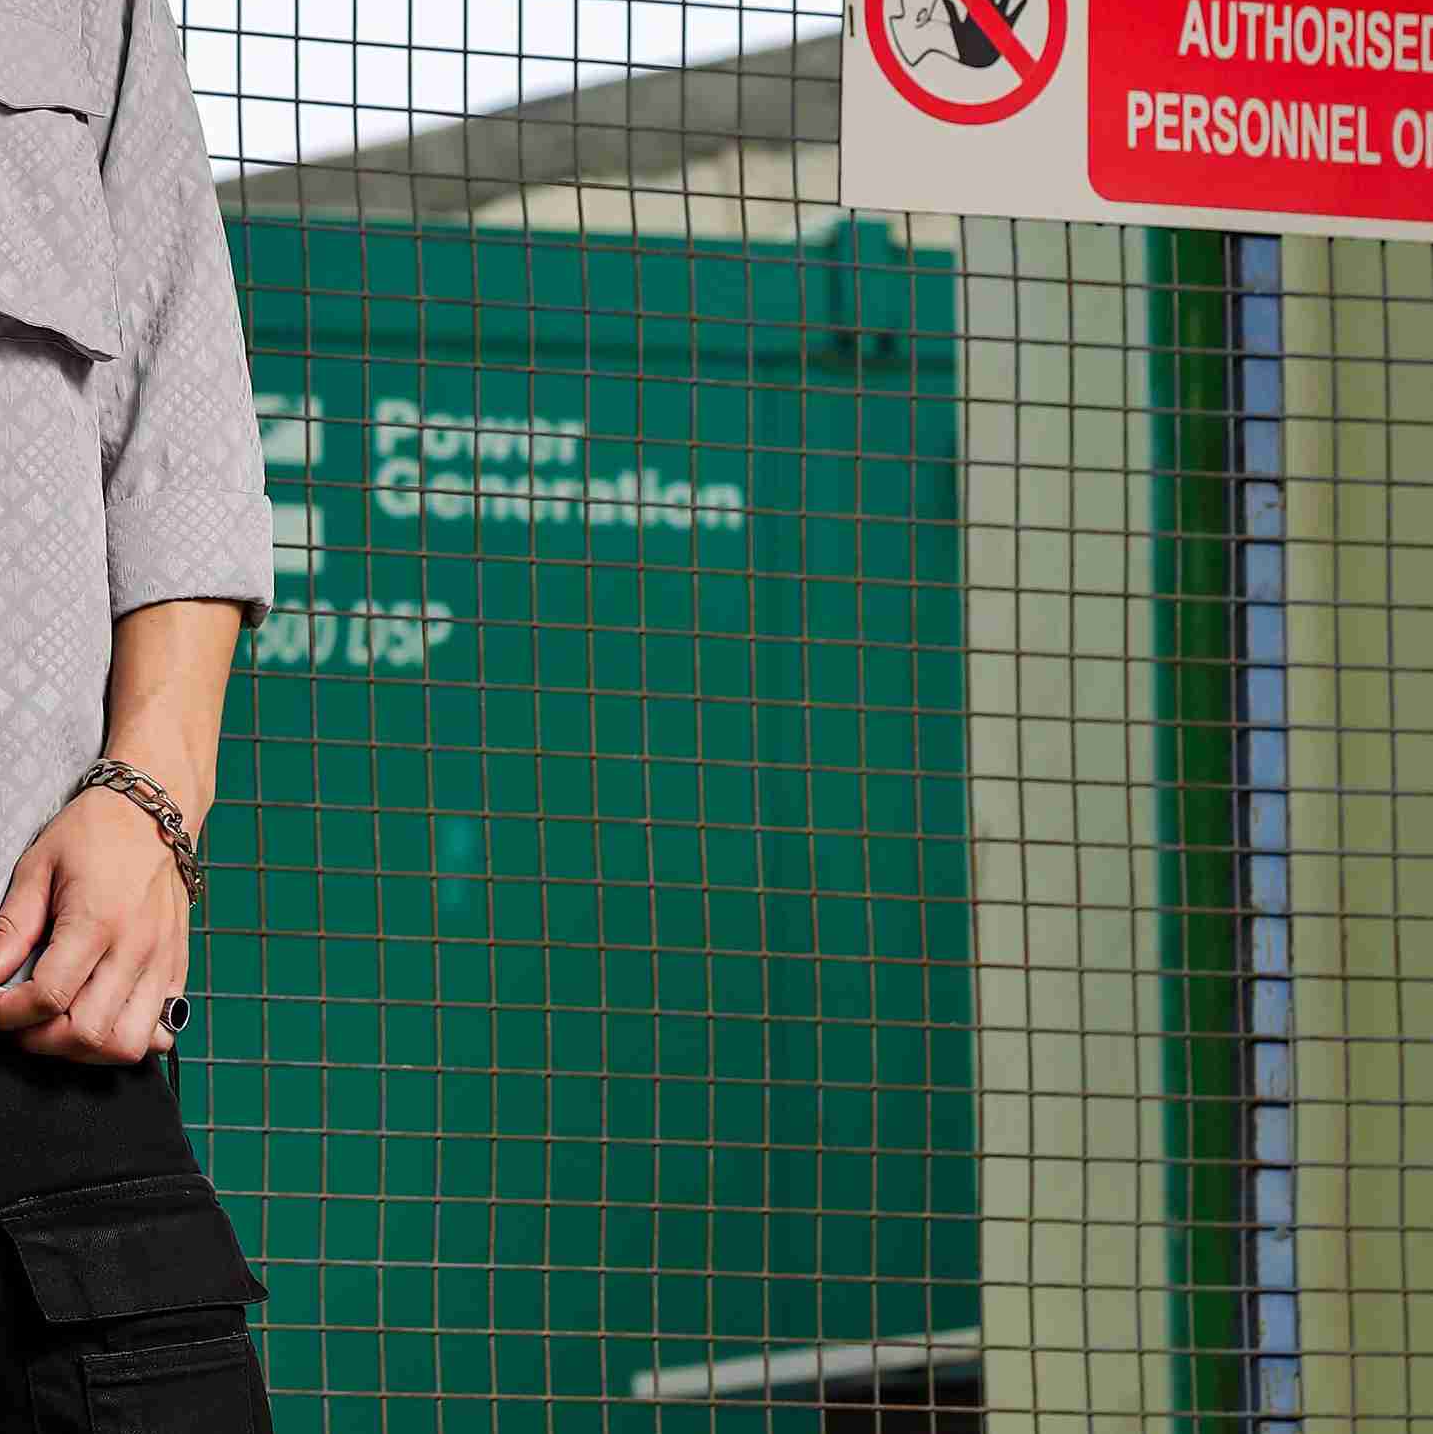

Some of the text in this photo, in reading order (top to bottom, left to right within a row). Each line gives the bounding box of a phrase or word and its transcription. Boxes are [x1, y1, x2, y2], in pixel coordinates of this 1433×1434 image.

[1126, 90, 1382, 166] PERSONNEL
[374, 399, 584, 465] Power
[374, 456, 744, 532] Generation
